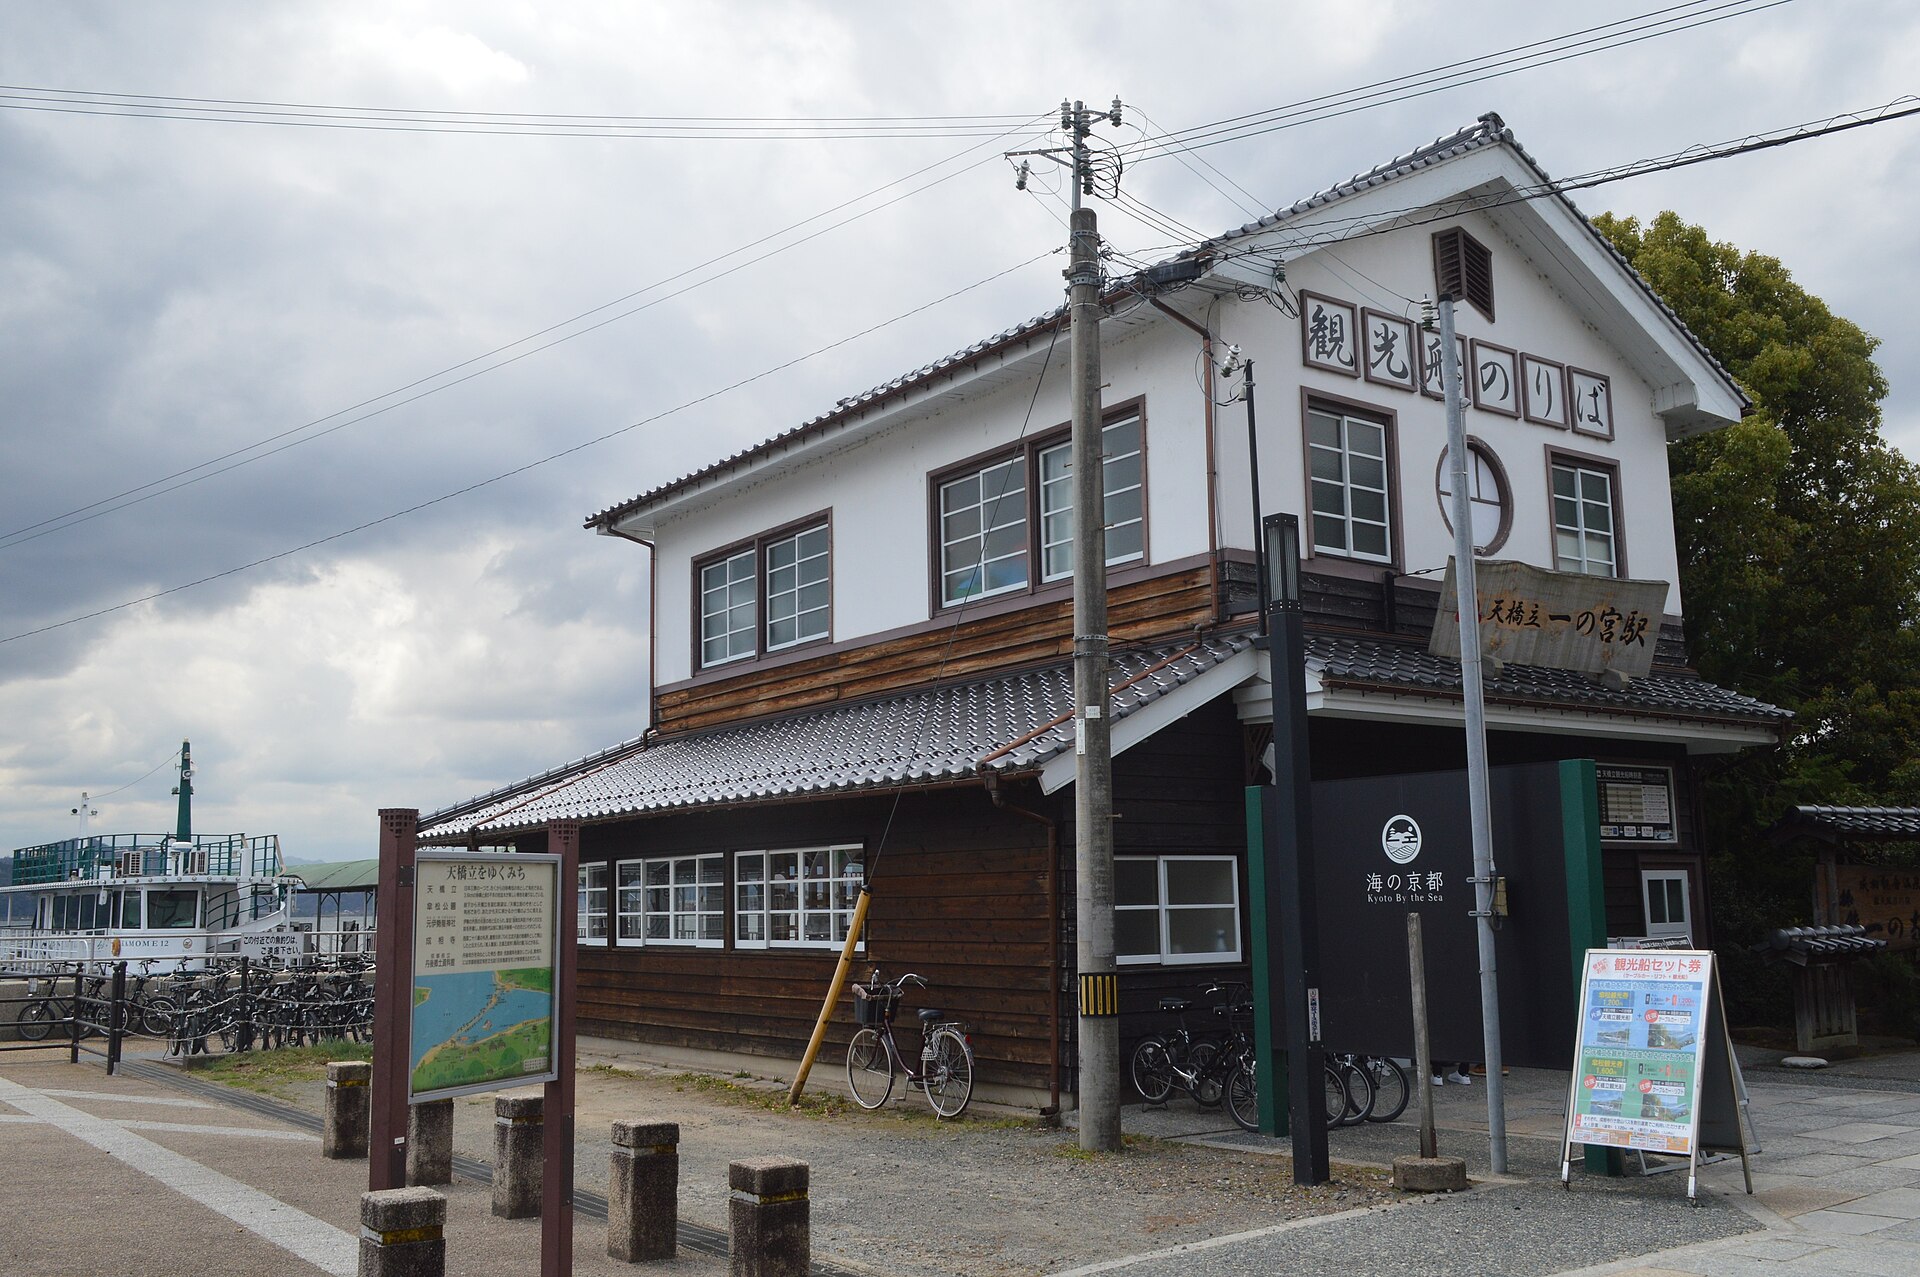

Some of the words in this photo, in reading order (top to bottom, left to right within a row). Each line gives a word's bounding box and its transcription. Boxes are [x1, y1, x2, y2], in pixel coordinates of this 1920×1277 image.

[446, 864, 526, 880] 天橋立をゆくみち
[1366, 871, 1443, 893] 海の京都
[1367, 894, 1393, 904] Kyoto
[1396, 894, 1407, 904] By
[1410, 893, 1424, 902] the
[1428, 893, 1443, 902] Sea
[1614, 957, 1702, 973] 観光船セット券
